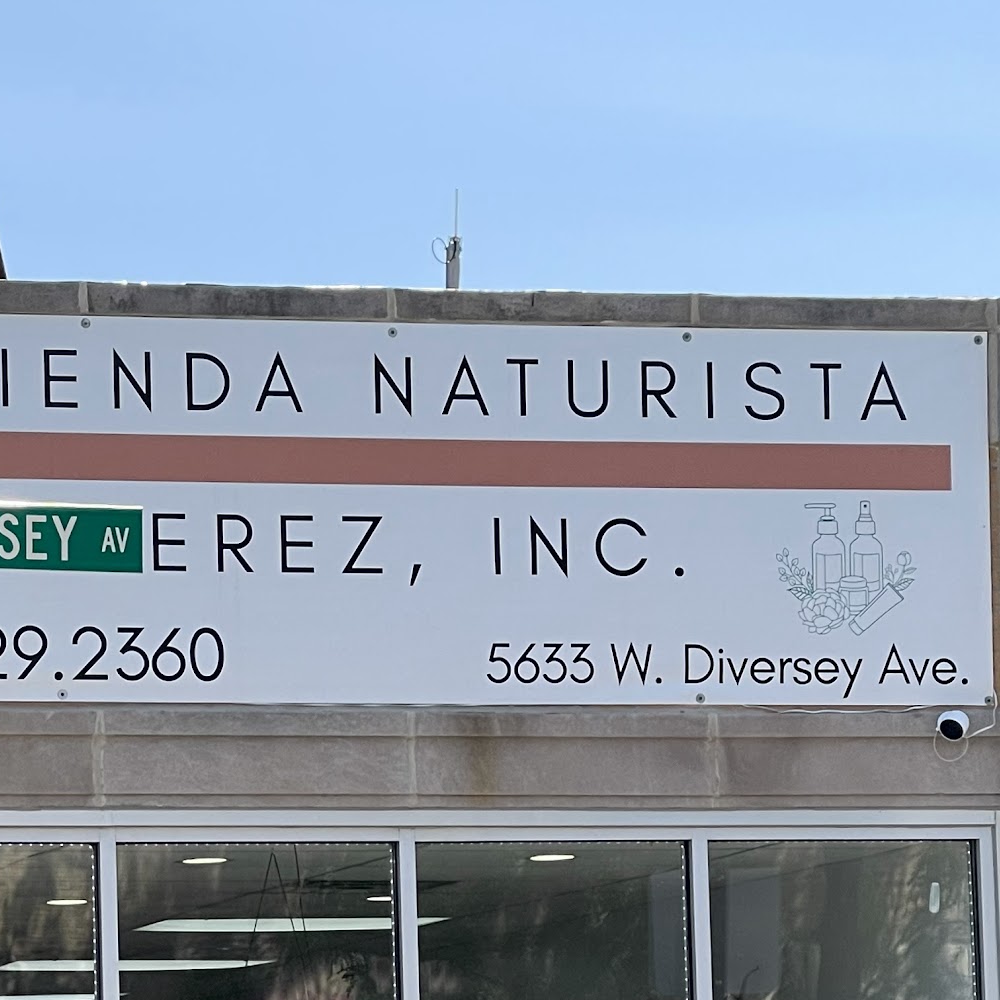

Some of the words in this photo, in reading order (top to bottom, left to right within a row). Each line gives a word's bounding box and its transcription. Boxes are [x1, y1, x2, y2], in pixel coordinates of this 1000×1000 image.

[373, 353, 907, 421] NATURISTA
[101, 526, 130, 554] AV
[152, 512, 423, 587] EREZ,
[493, 515, 686, 578] INC.
[486, 642, 595, 685] 5633
[610, 642, 663, 686] W.
[683, 643, 864, 699] Diversey
[878, 643, 969, 686] Ave.
